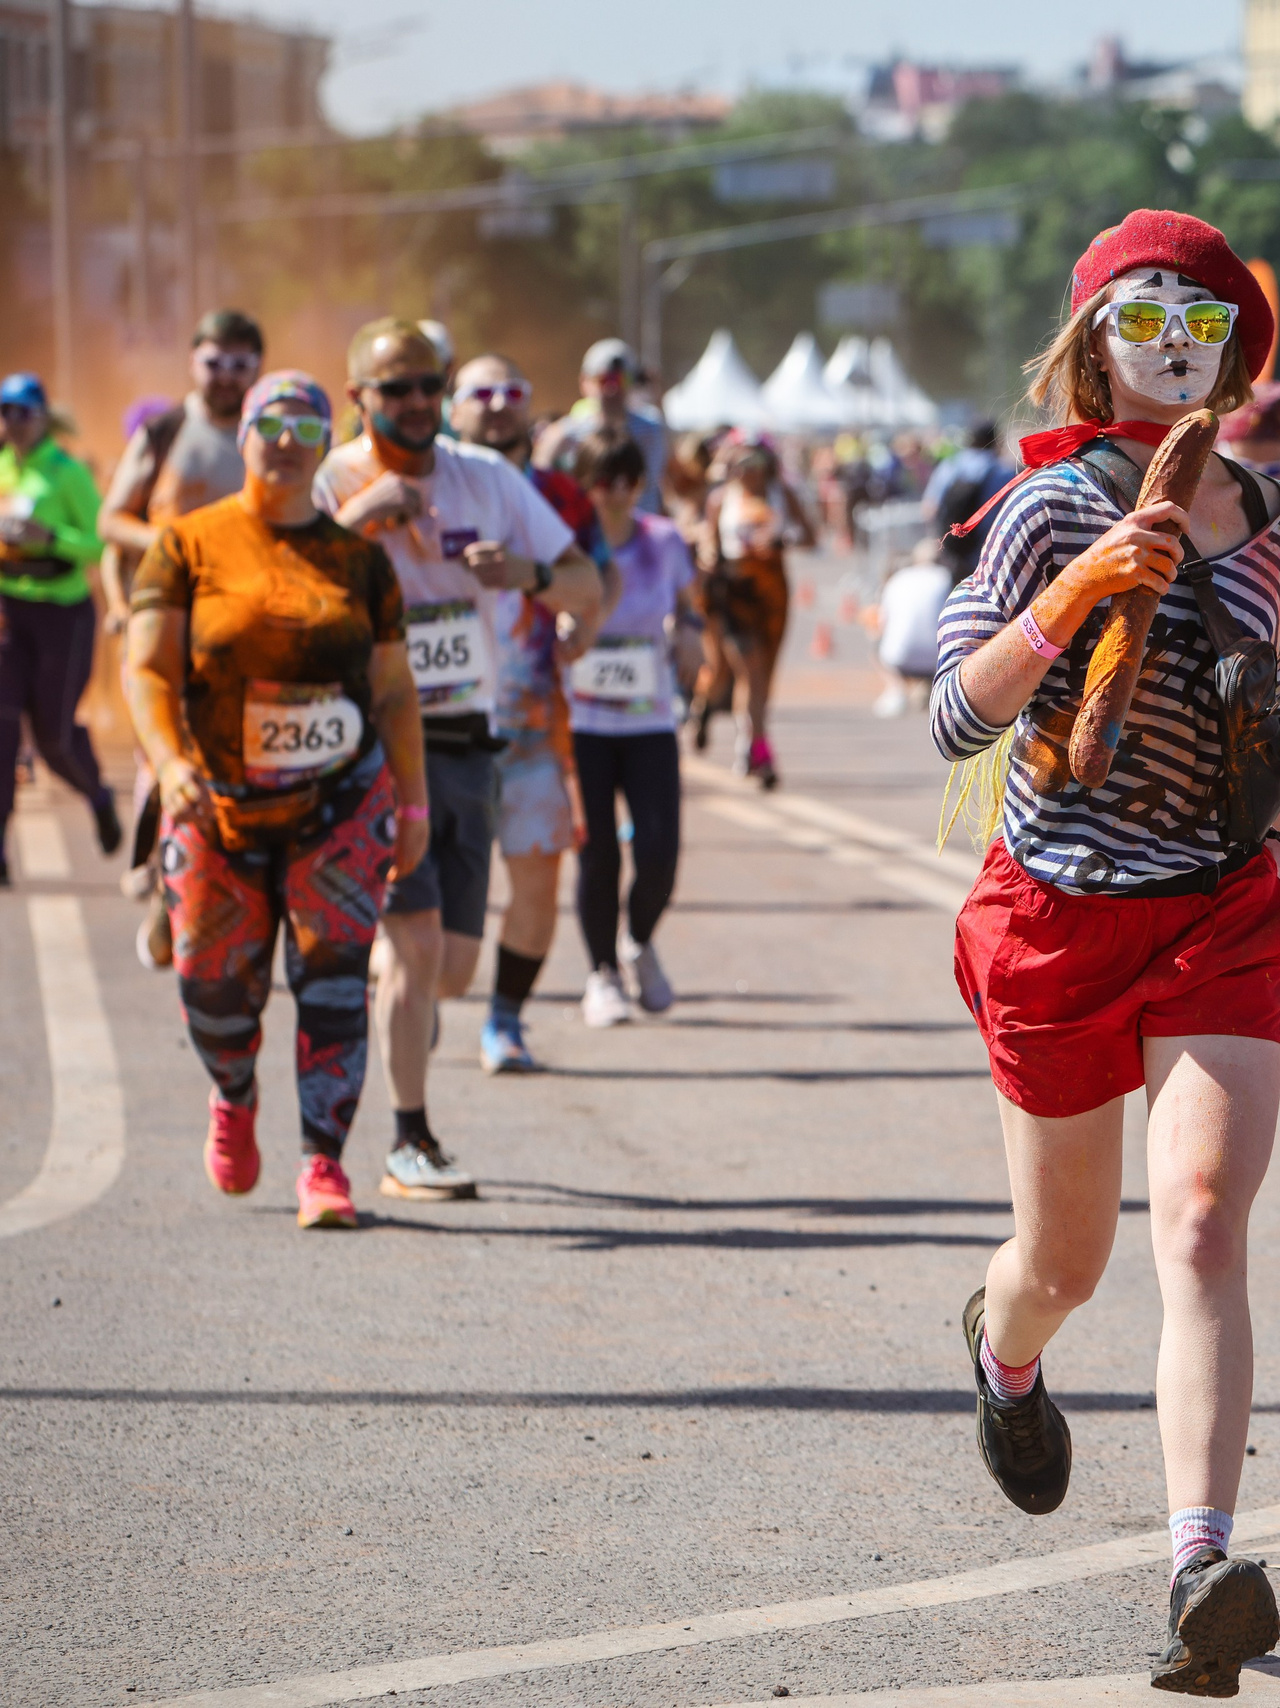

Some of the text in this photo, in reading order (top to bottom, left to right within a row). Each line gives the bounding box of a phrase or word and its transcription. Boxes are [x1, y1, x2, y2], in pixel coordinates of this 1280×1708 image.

[1022, 617, 1043, 649] 5350
[406, 634, 470, 672] 365
[261, 717, 344, 753] 2363
